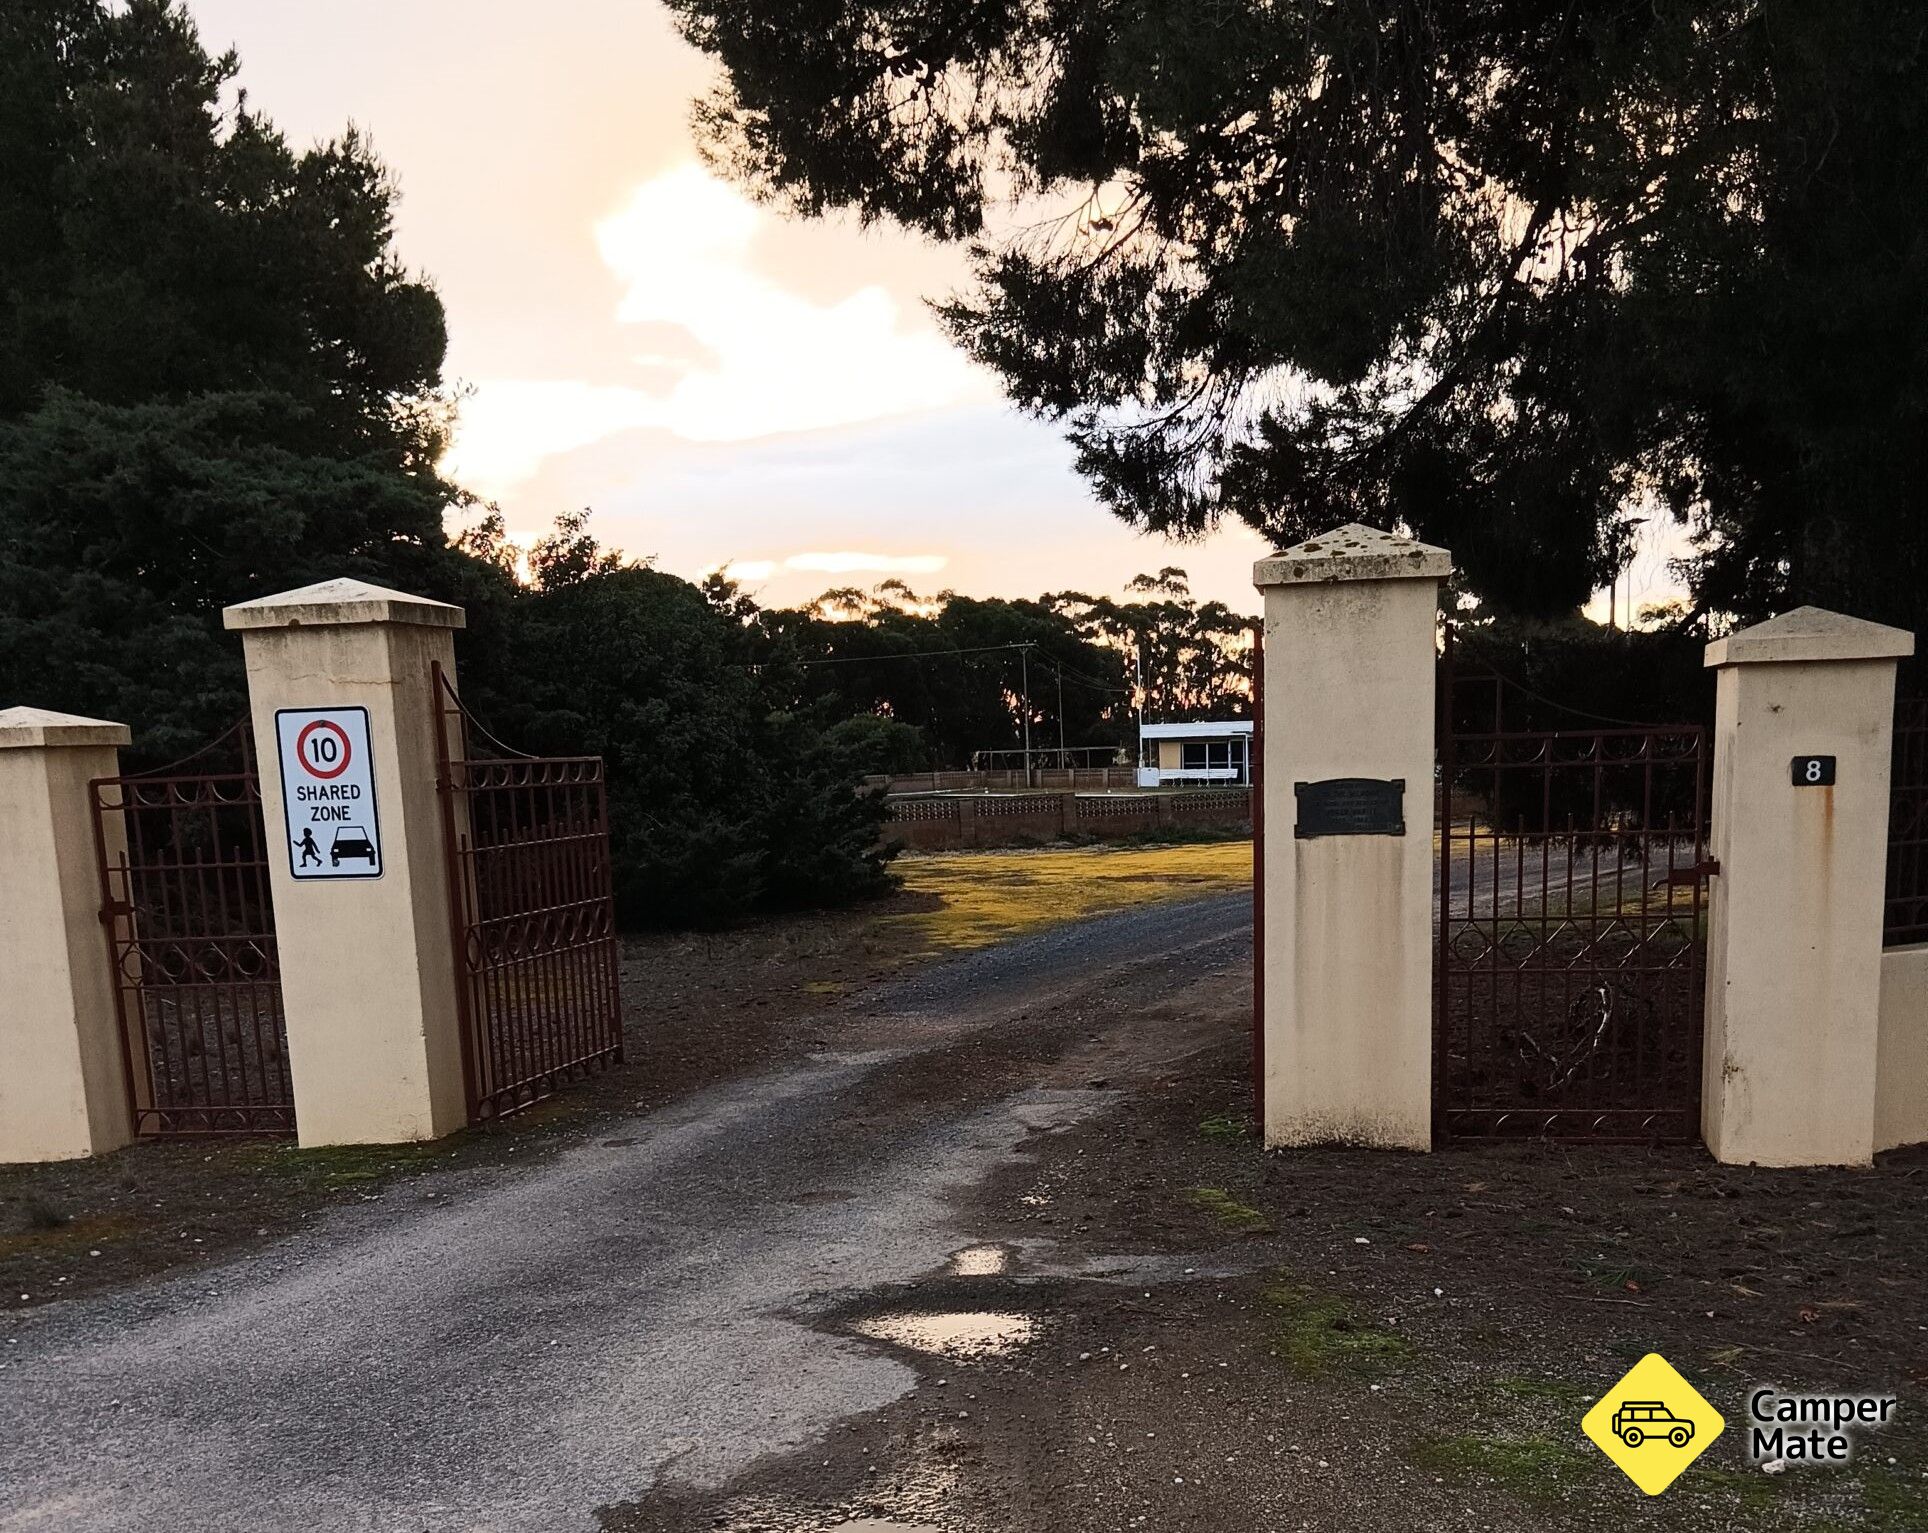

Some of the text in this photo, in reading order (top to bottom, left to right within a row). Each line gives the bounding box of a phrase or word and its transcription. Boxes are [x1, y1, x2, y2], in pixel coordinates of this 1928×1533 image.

[311, 737, 337, 763] 10
[1805, 760, 1821, 782] 8
[297, 784, 361, 801] SHARED
[310, 806, 352, 822] ZONE
